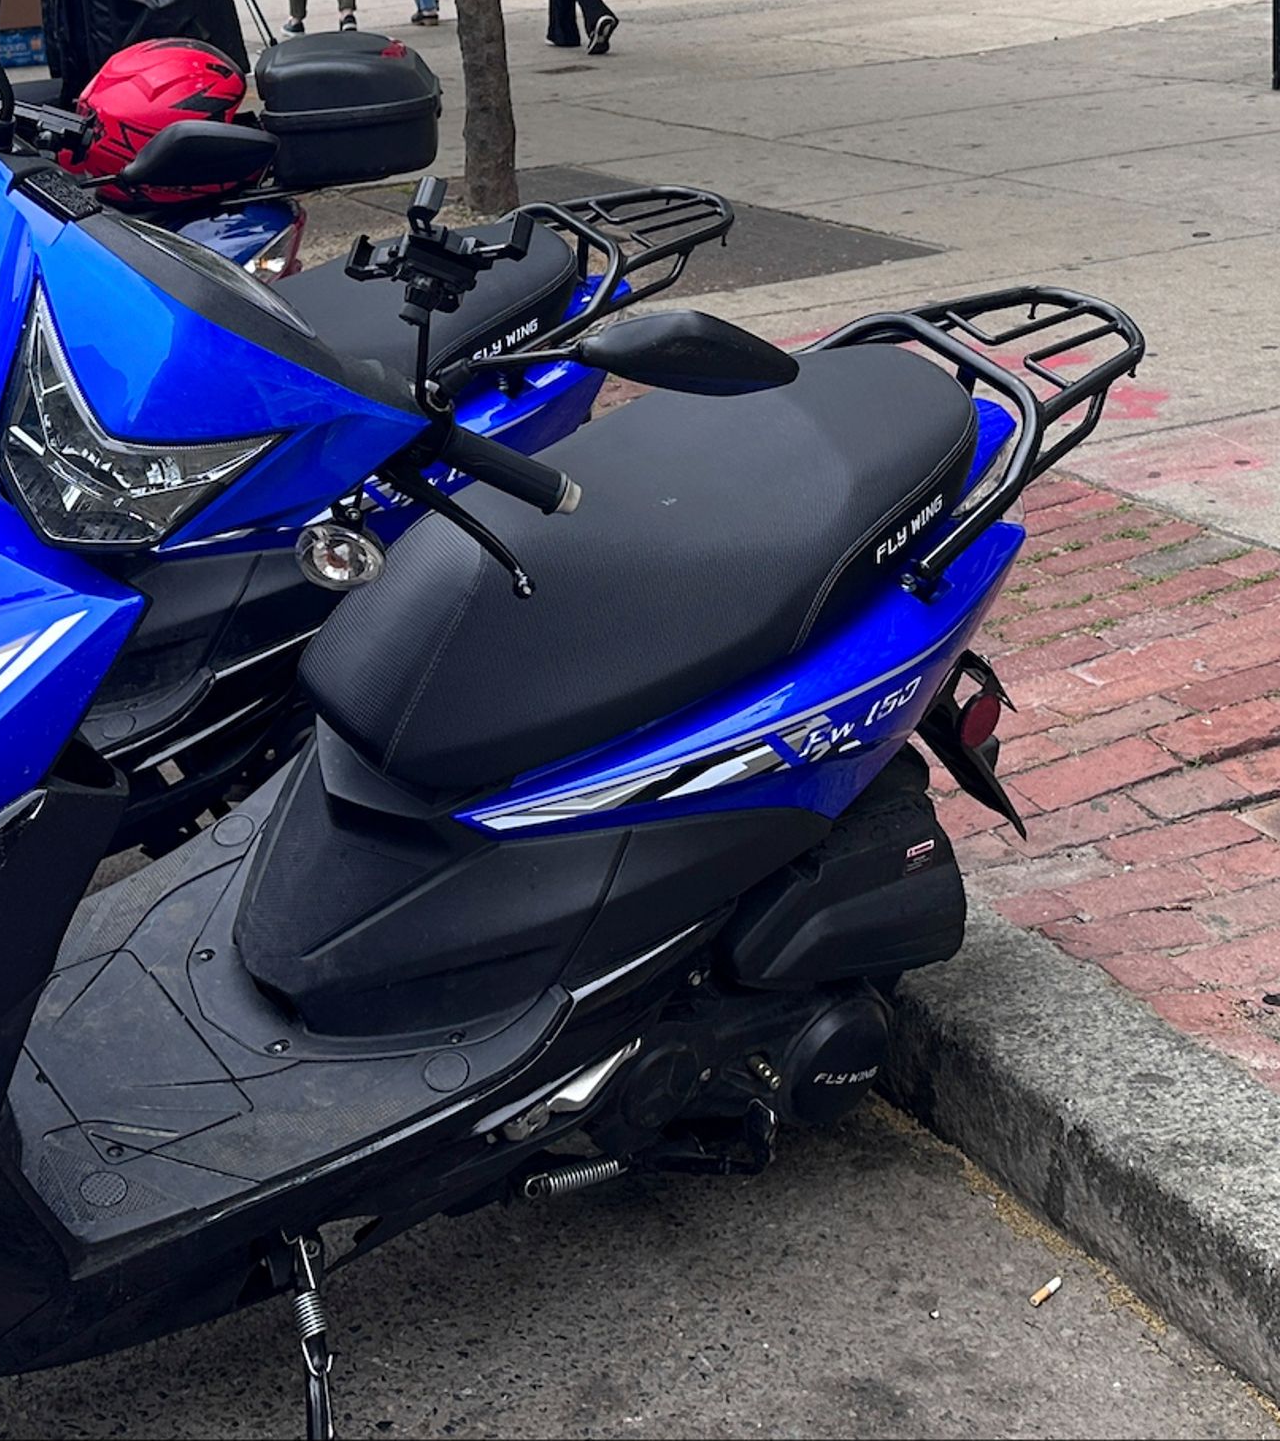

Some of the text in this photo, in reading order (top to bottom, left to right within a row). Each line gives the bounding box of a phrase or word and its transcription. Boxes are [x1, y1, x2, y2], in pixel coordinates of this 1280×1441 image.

[505, 317, 539, 348] WING
[876, 493, 943, 565] FLY WING
[864, 675, 922, 727] 150
[813, 1065, 879, 1085] FLY WING
